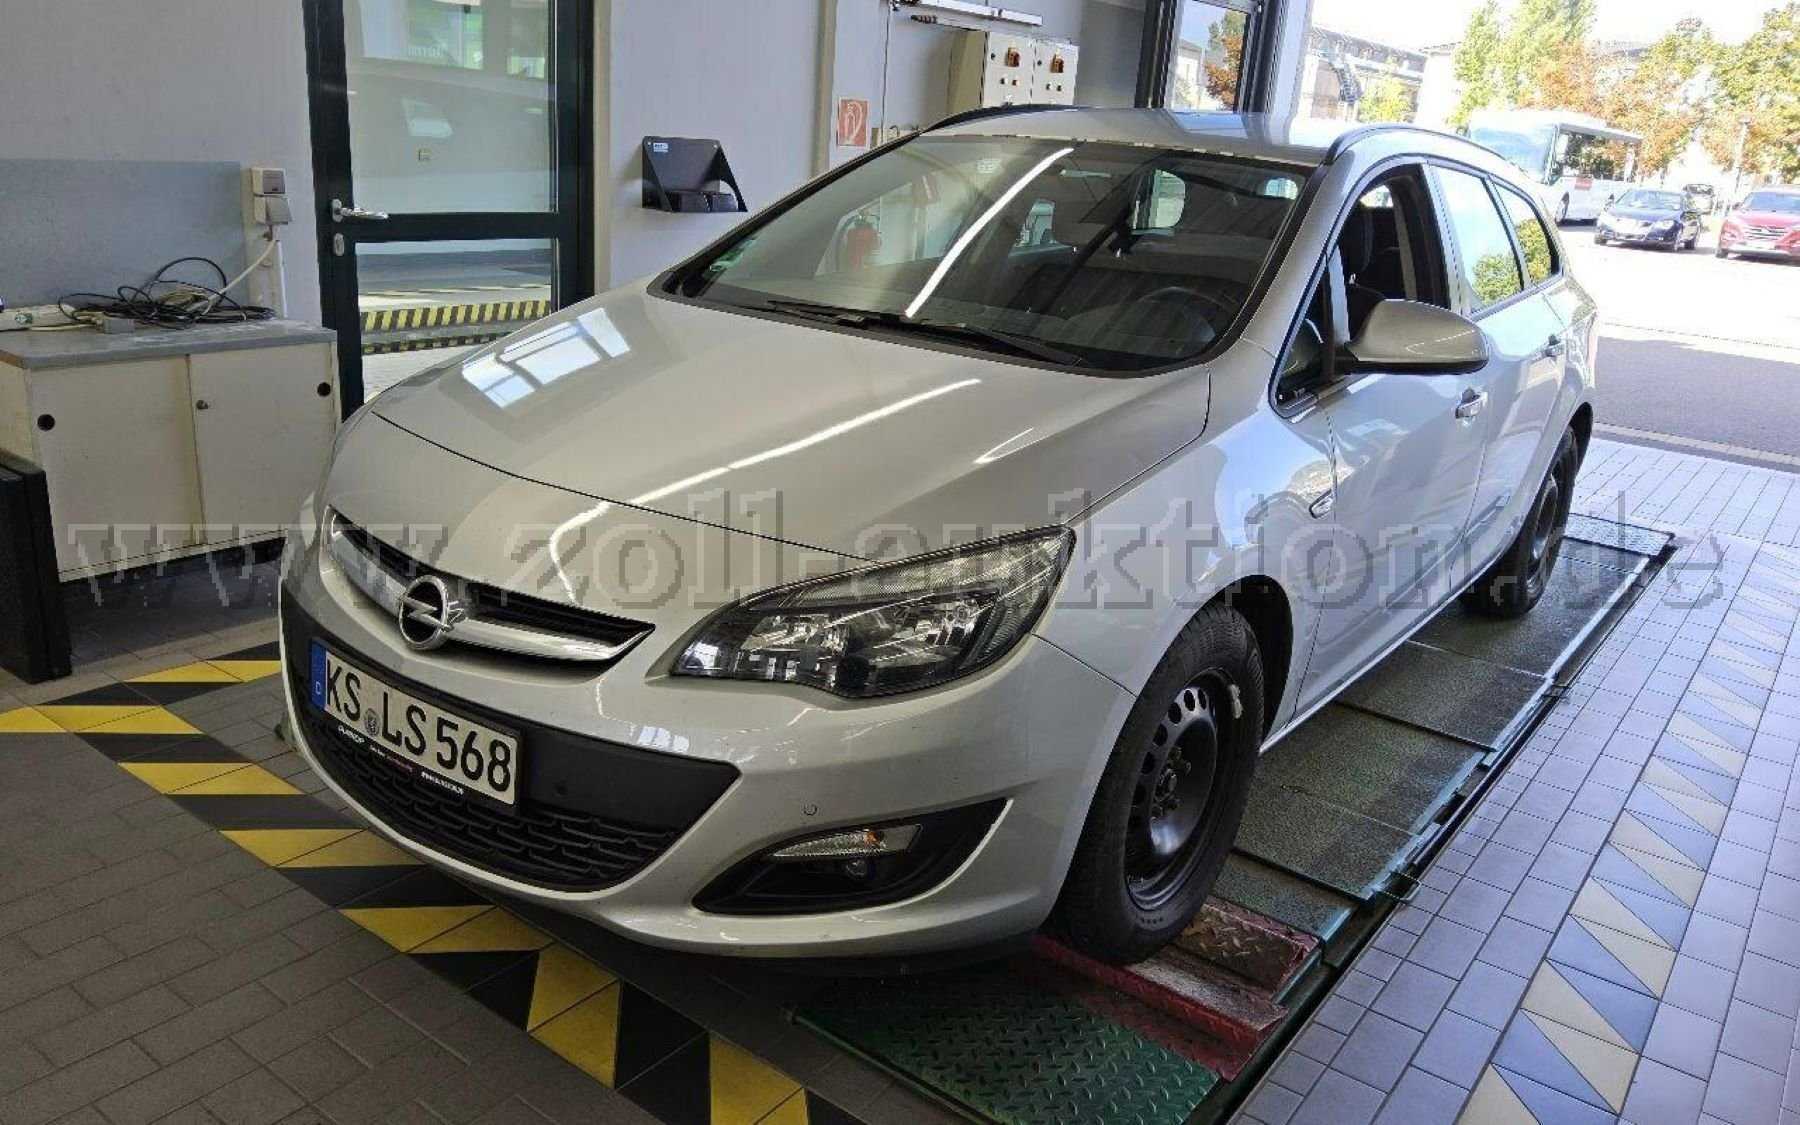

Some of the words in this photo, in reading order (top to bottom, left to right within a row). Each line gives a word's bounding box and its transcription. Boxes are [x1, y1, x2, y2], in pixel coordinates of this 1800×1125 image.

[327, 659, 361, 721] KS
[382, 691, 427, 756] LS
[436, 717, 511, 792] 568
